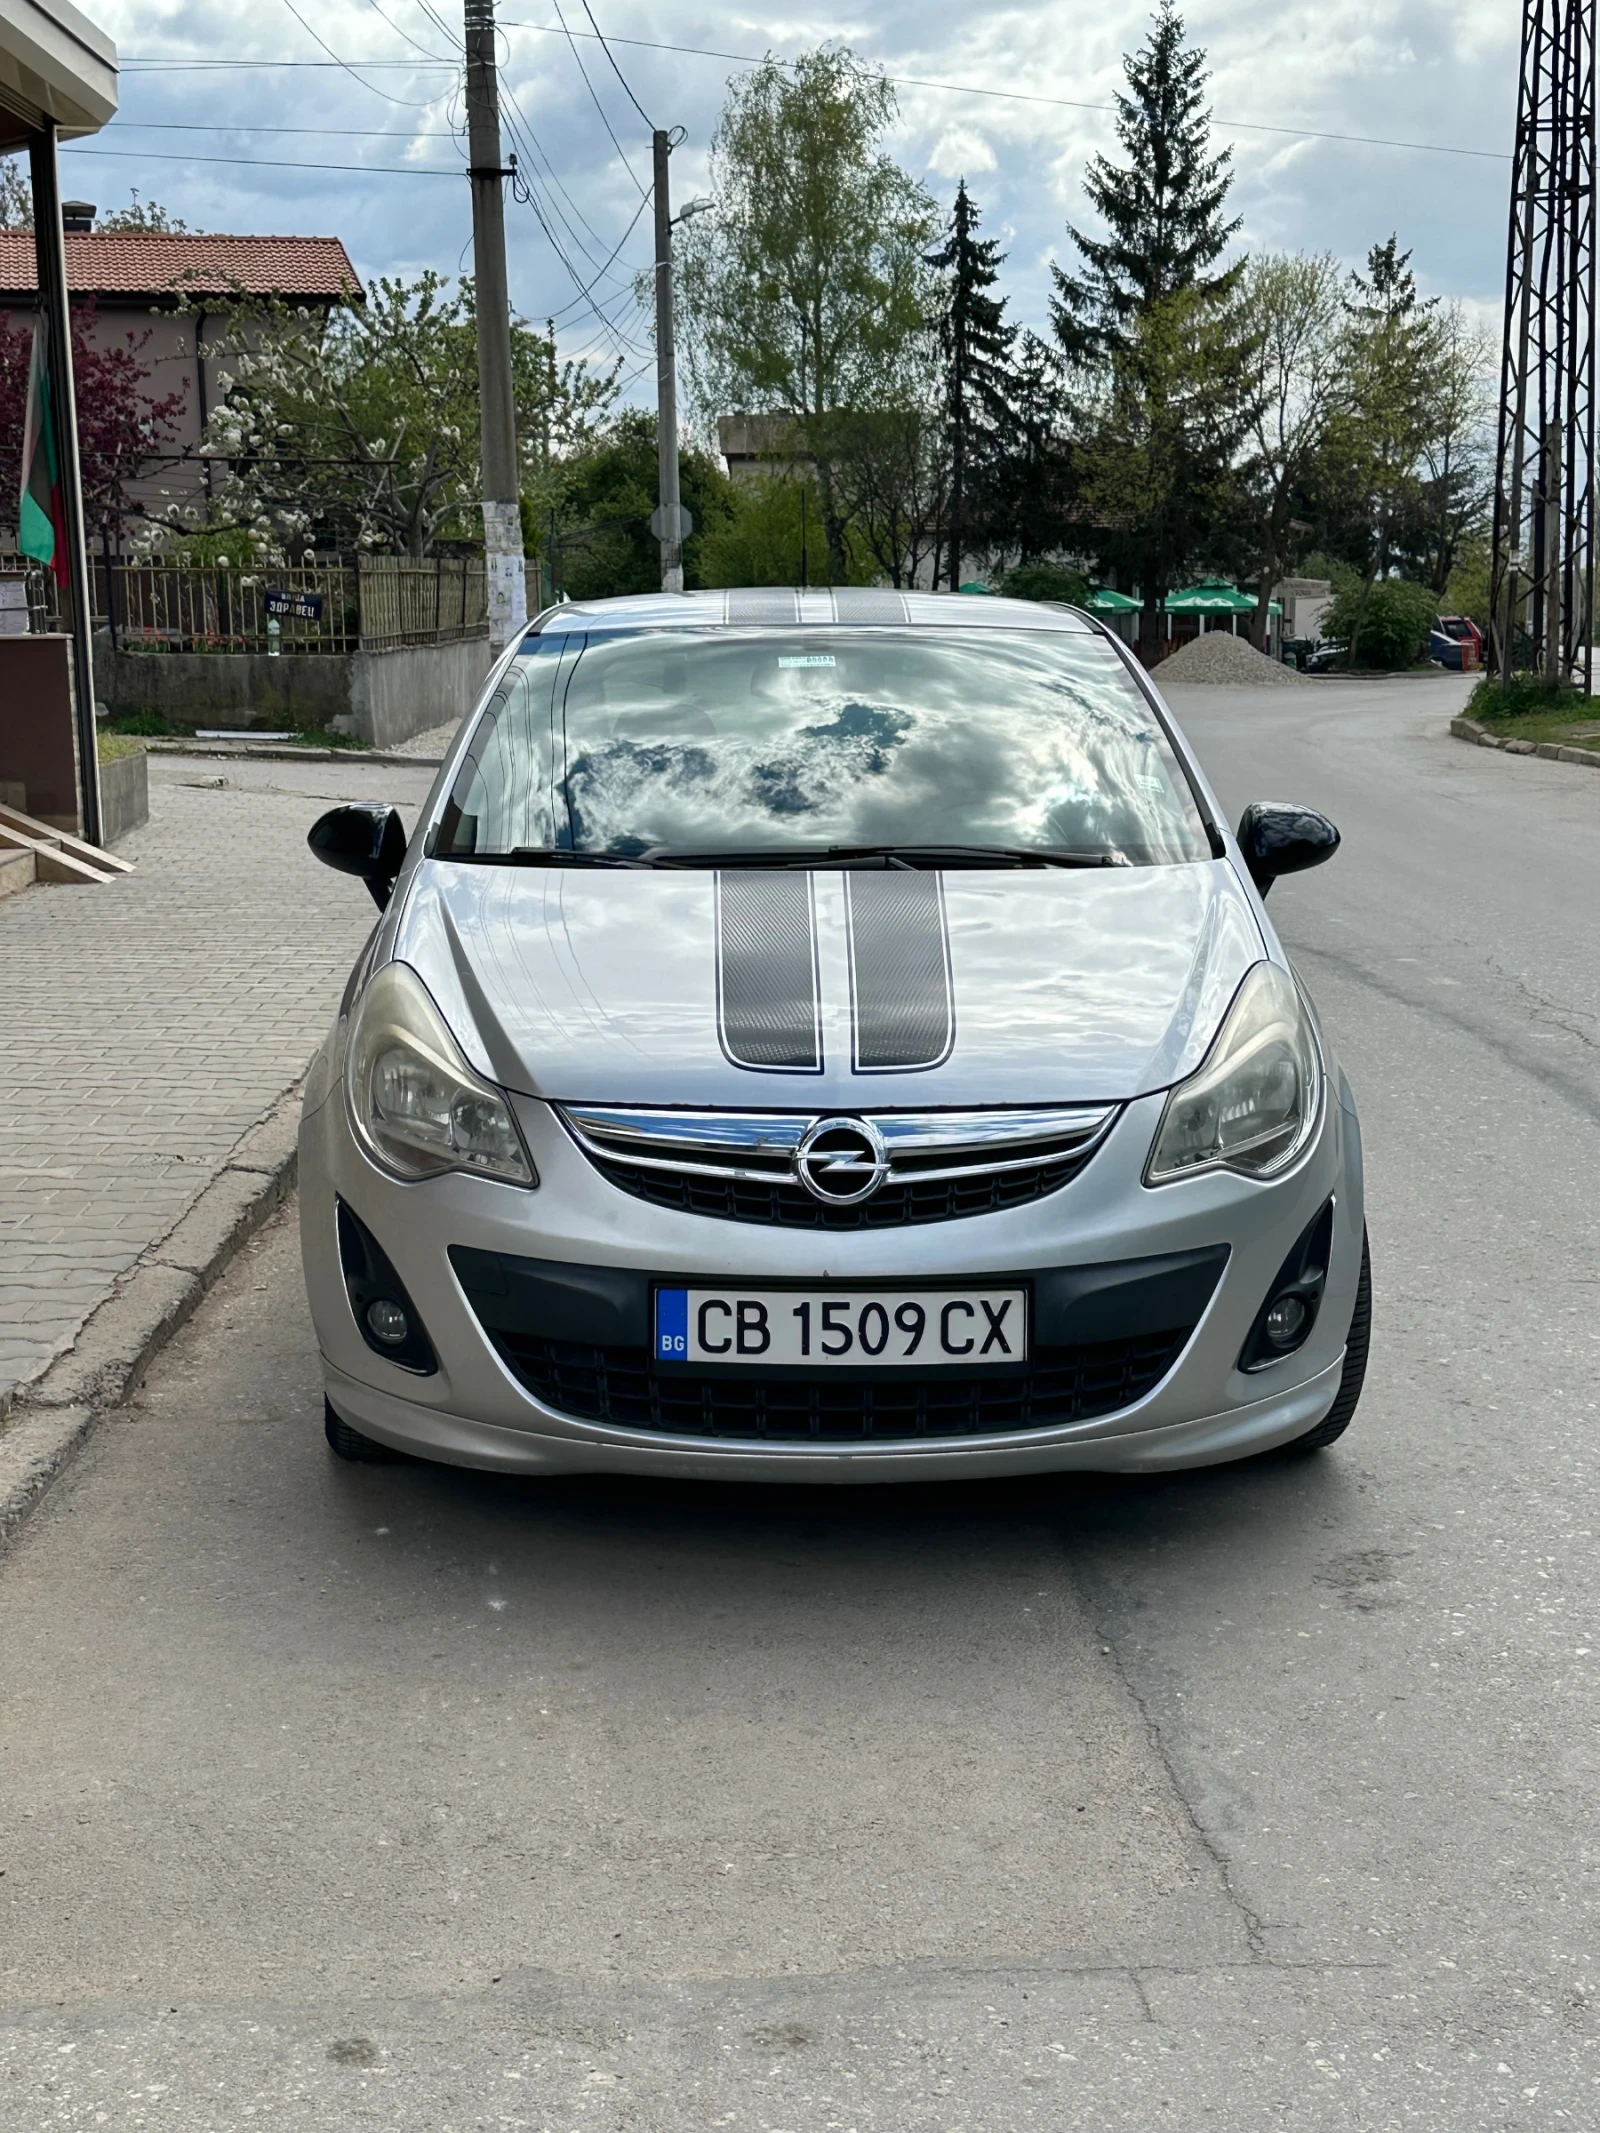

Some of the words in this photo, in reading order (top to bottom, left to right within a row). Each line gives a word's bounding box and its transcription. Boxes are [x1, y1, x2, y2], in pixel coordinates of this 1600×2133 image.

[270, 601, 315, 617] ЗДРАВЕЦ
[697, 1299, 771, 1355] CB
[792, 1301, 926, 1356] 1509
[940, 1299, 1013, 1355] CX
[661, 1335, 685, 1352] BG
